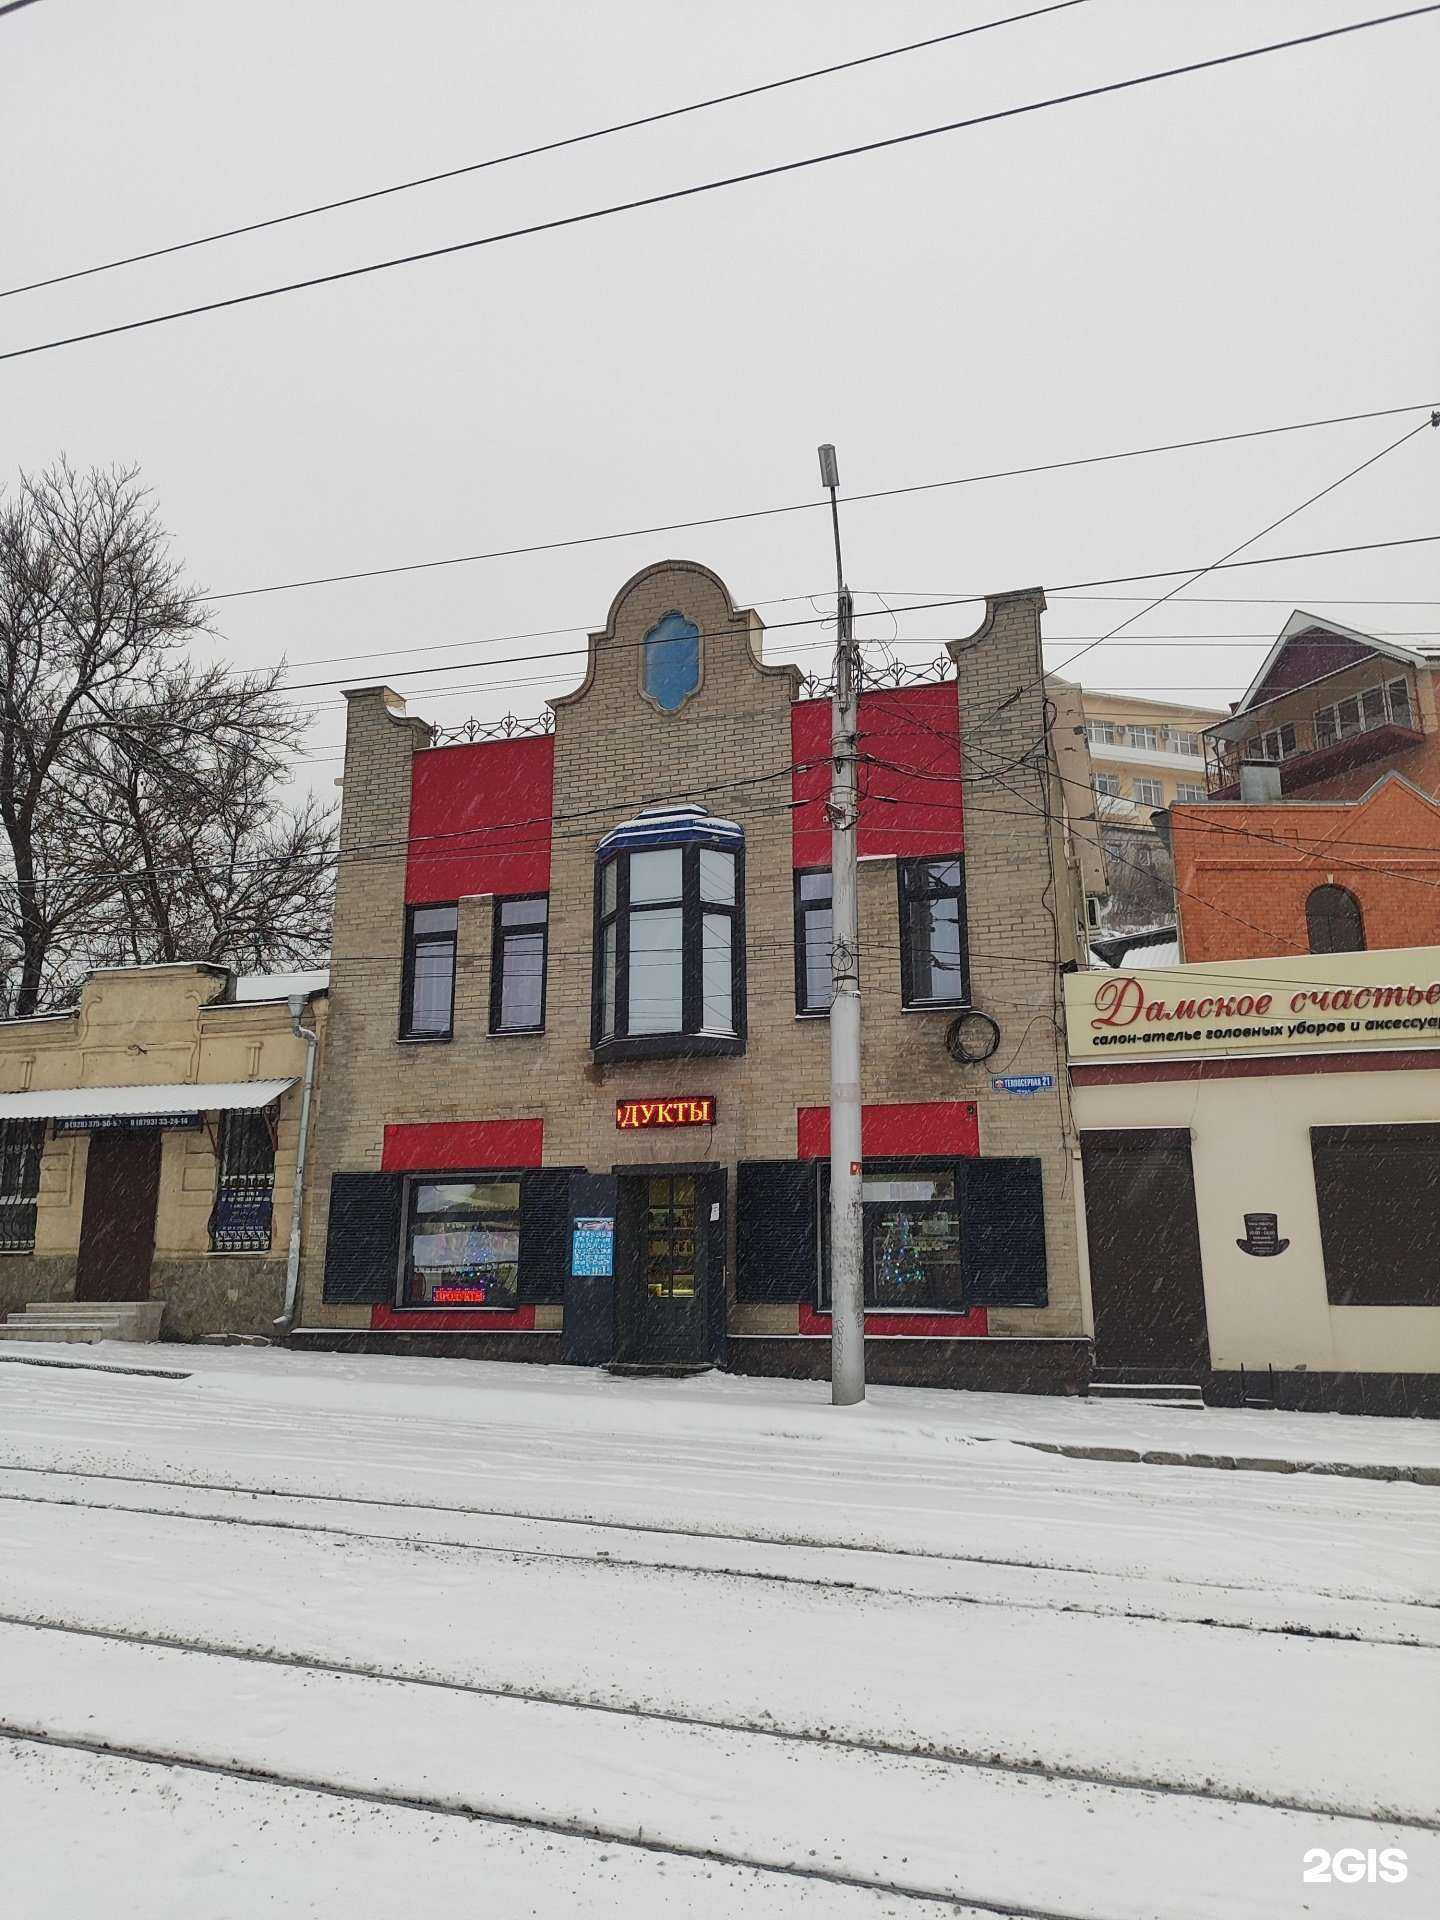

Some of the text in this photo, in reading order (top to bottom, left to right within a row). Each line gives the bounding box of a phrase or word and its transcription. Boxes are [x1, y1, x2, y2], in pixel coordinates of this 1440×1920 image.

[1091, 977, 1440, 1030] Дамское счастье
[1092, 1016, 1440, 1046] салон-ателье головных уборов и аксессуа
[617, 1101, 711, 1128] ДУКТЫ
